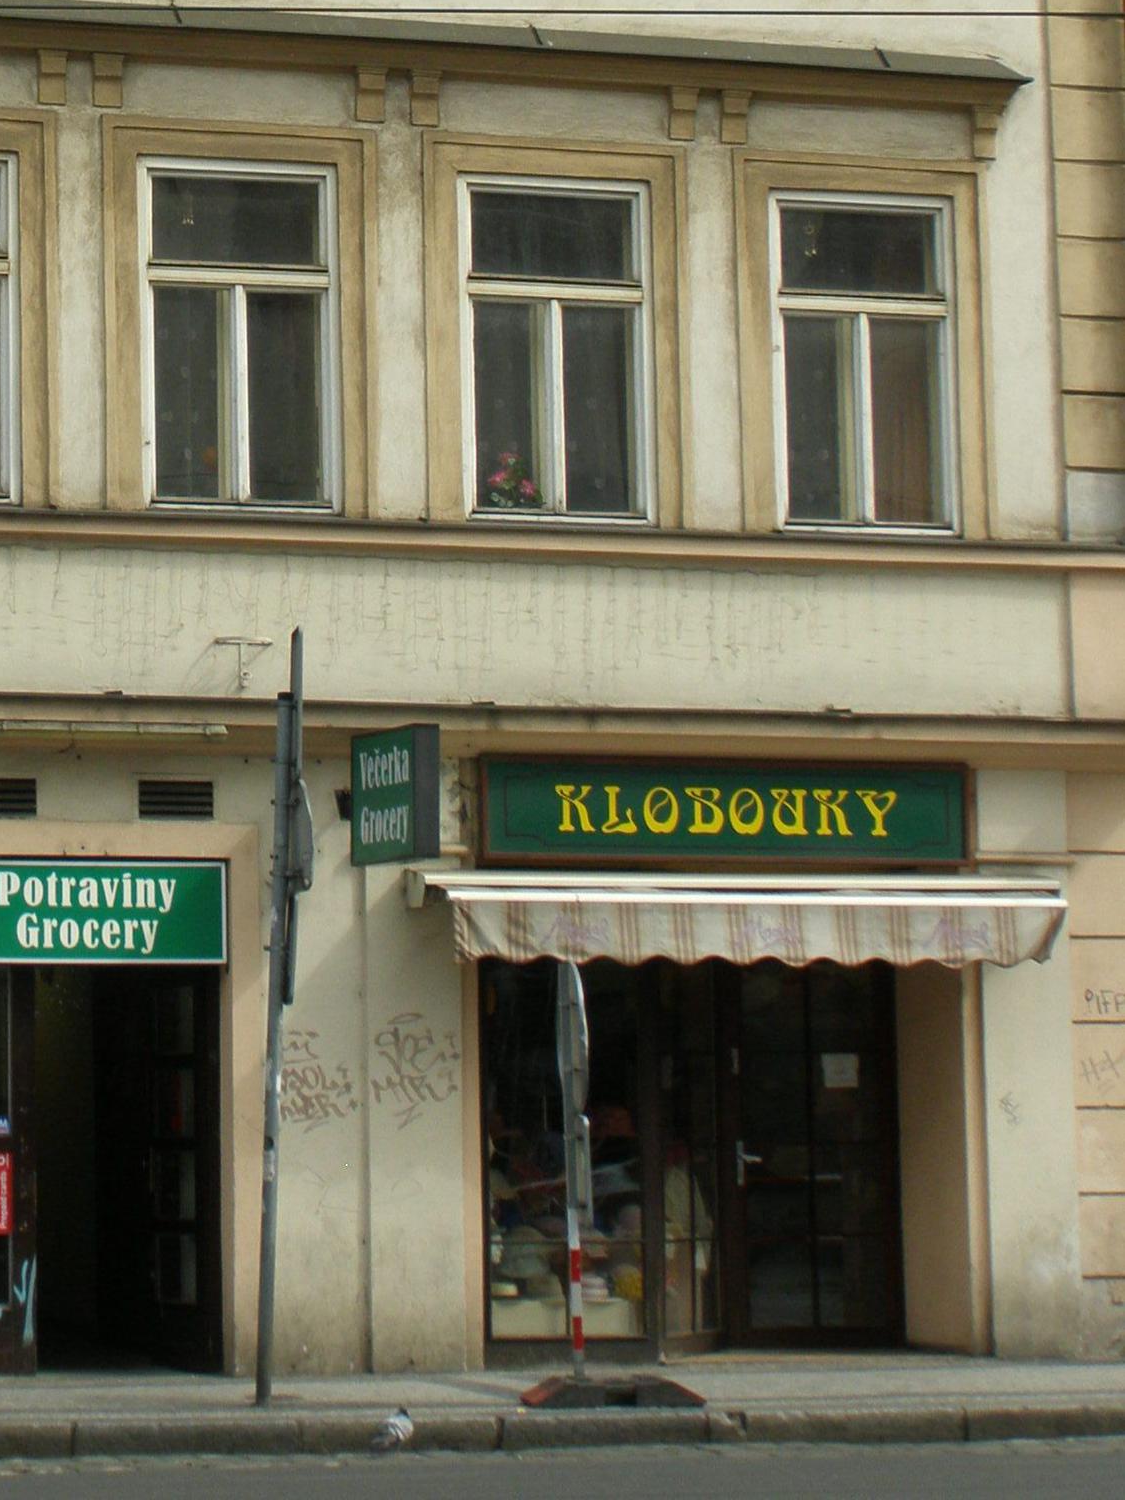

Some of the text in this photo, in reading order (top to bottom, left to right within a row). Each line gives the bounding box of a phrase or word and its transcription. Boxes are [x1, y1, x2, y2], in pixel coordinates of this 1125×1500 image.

[359, 745, 410, 791] Večerka
[361, 805, 409, 845] Grocery
[554, 784, 898, 837] KLOBOUKY
[15, 912, 159, 955] Grocery
